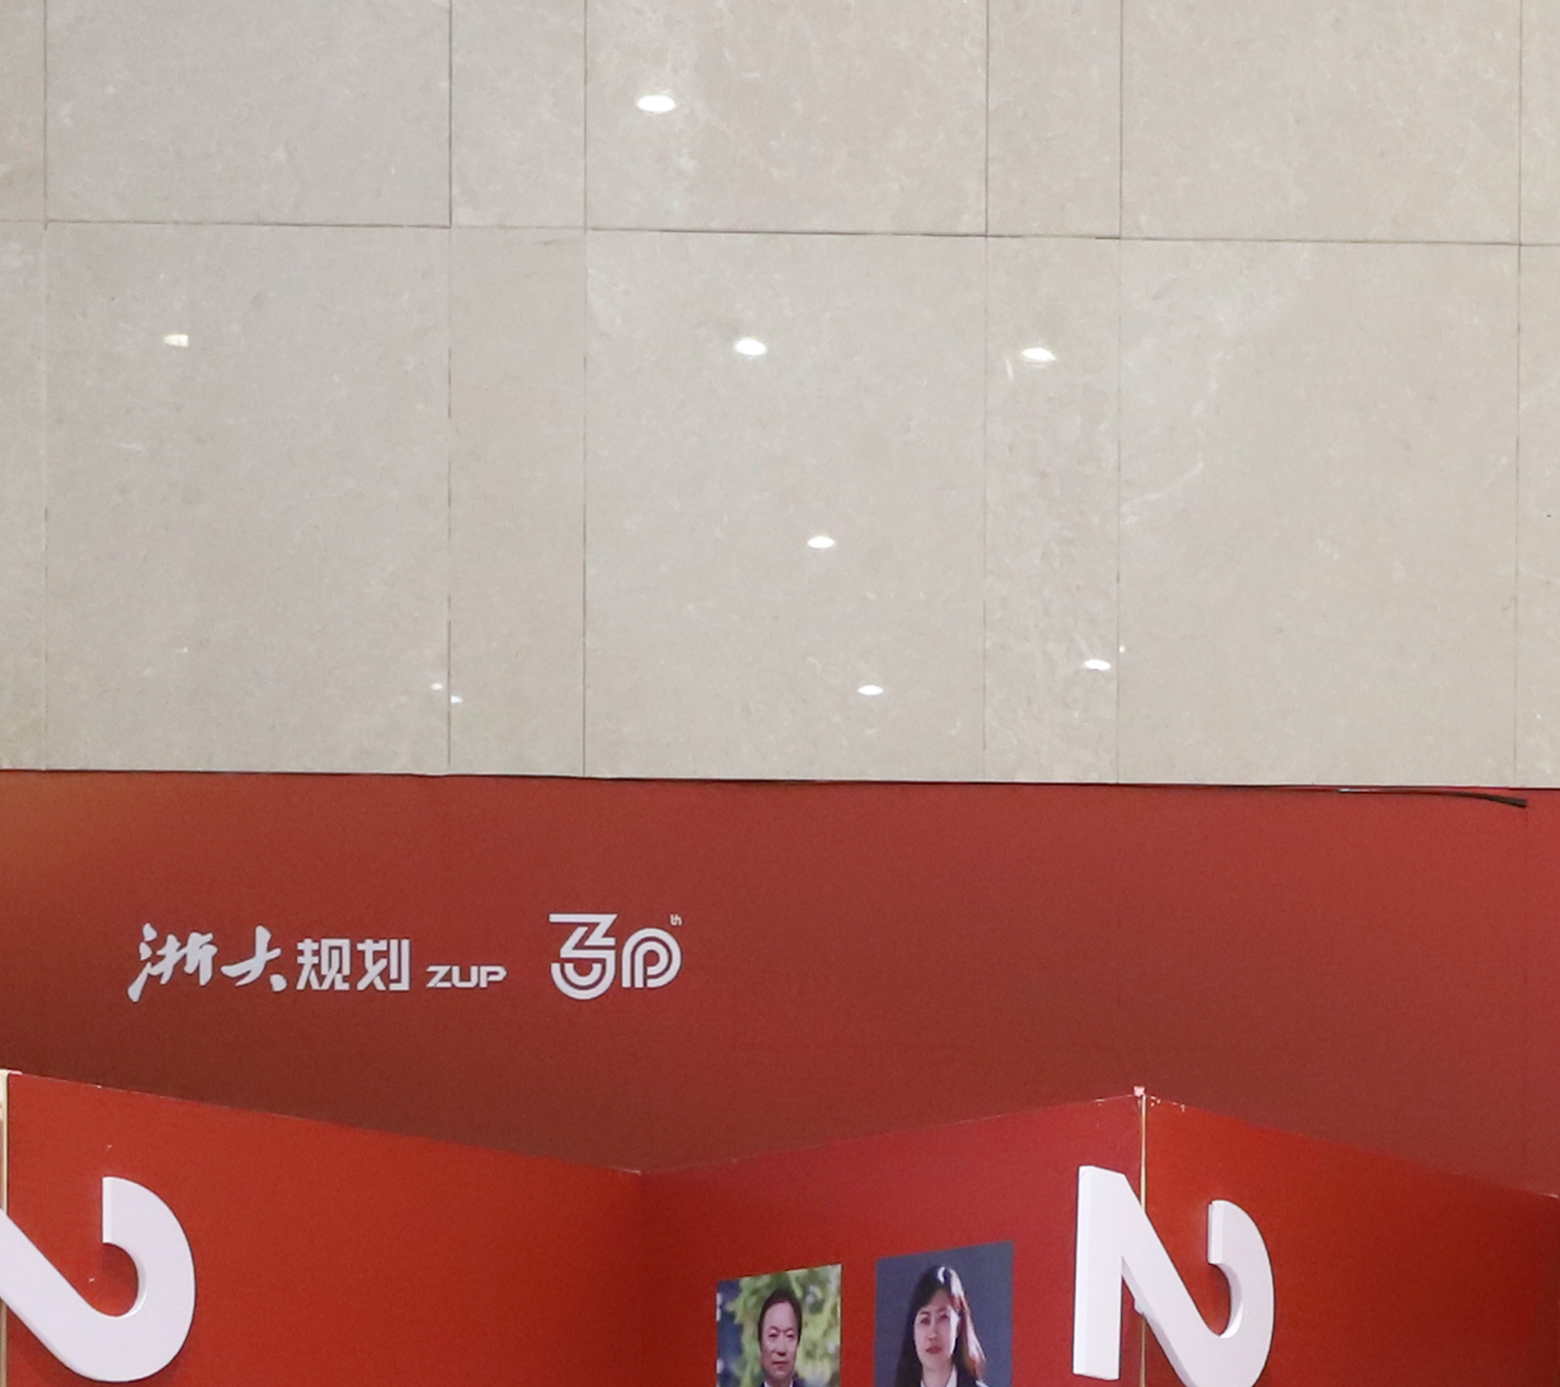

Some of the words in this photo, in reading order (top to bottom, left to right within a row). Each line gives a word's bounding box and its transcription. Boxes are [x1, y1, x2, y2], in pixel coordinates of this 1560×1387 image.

[127, 923, 410, 1002] 浙大规划
[427, 965, 508, 988] ZUP
